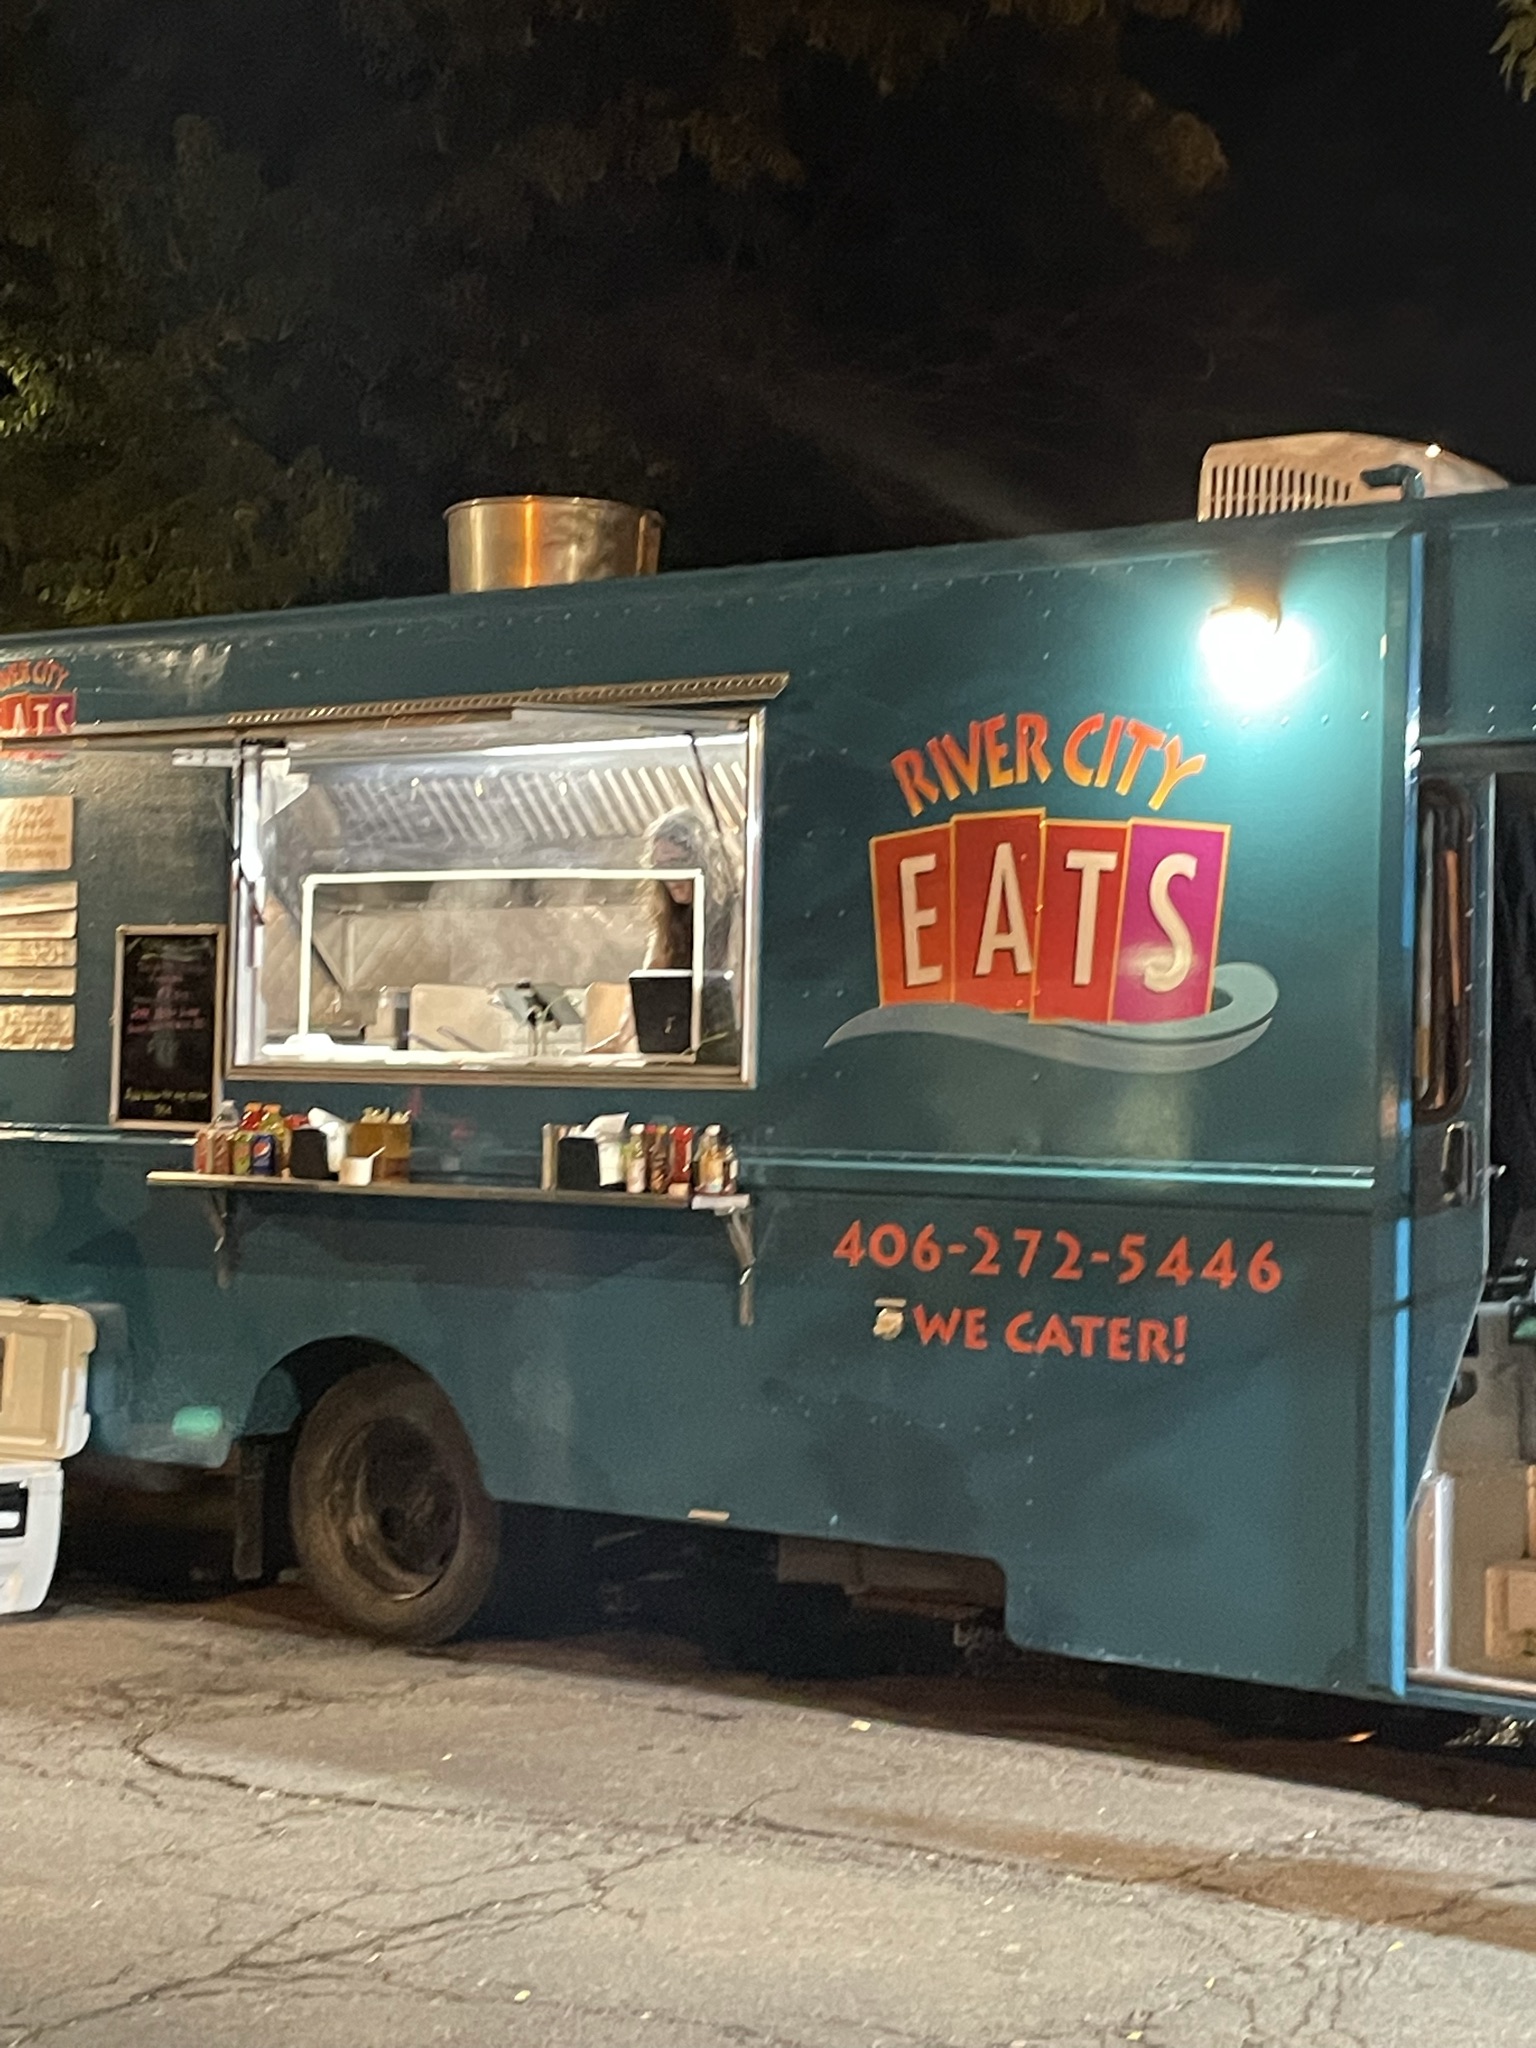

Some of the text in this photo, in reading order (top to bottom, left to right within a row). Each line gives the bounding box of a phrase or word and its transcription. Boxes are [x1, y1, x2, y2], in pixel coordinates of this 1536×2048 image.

[32, 659, 69, 690] CITY
[0, 703, 69, 736] ATS
[890, 712, 1206, 817] RIVER CITY
[899, 842, 1199, 993] EATS
[833, 1219, 1283, 1293] 406-272-5446
[913, 1304, 1189, 1365] WE CATER!
